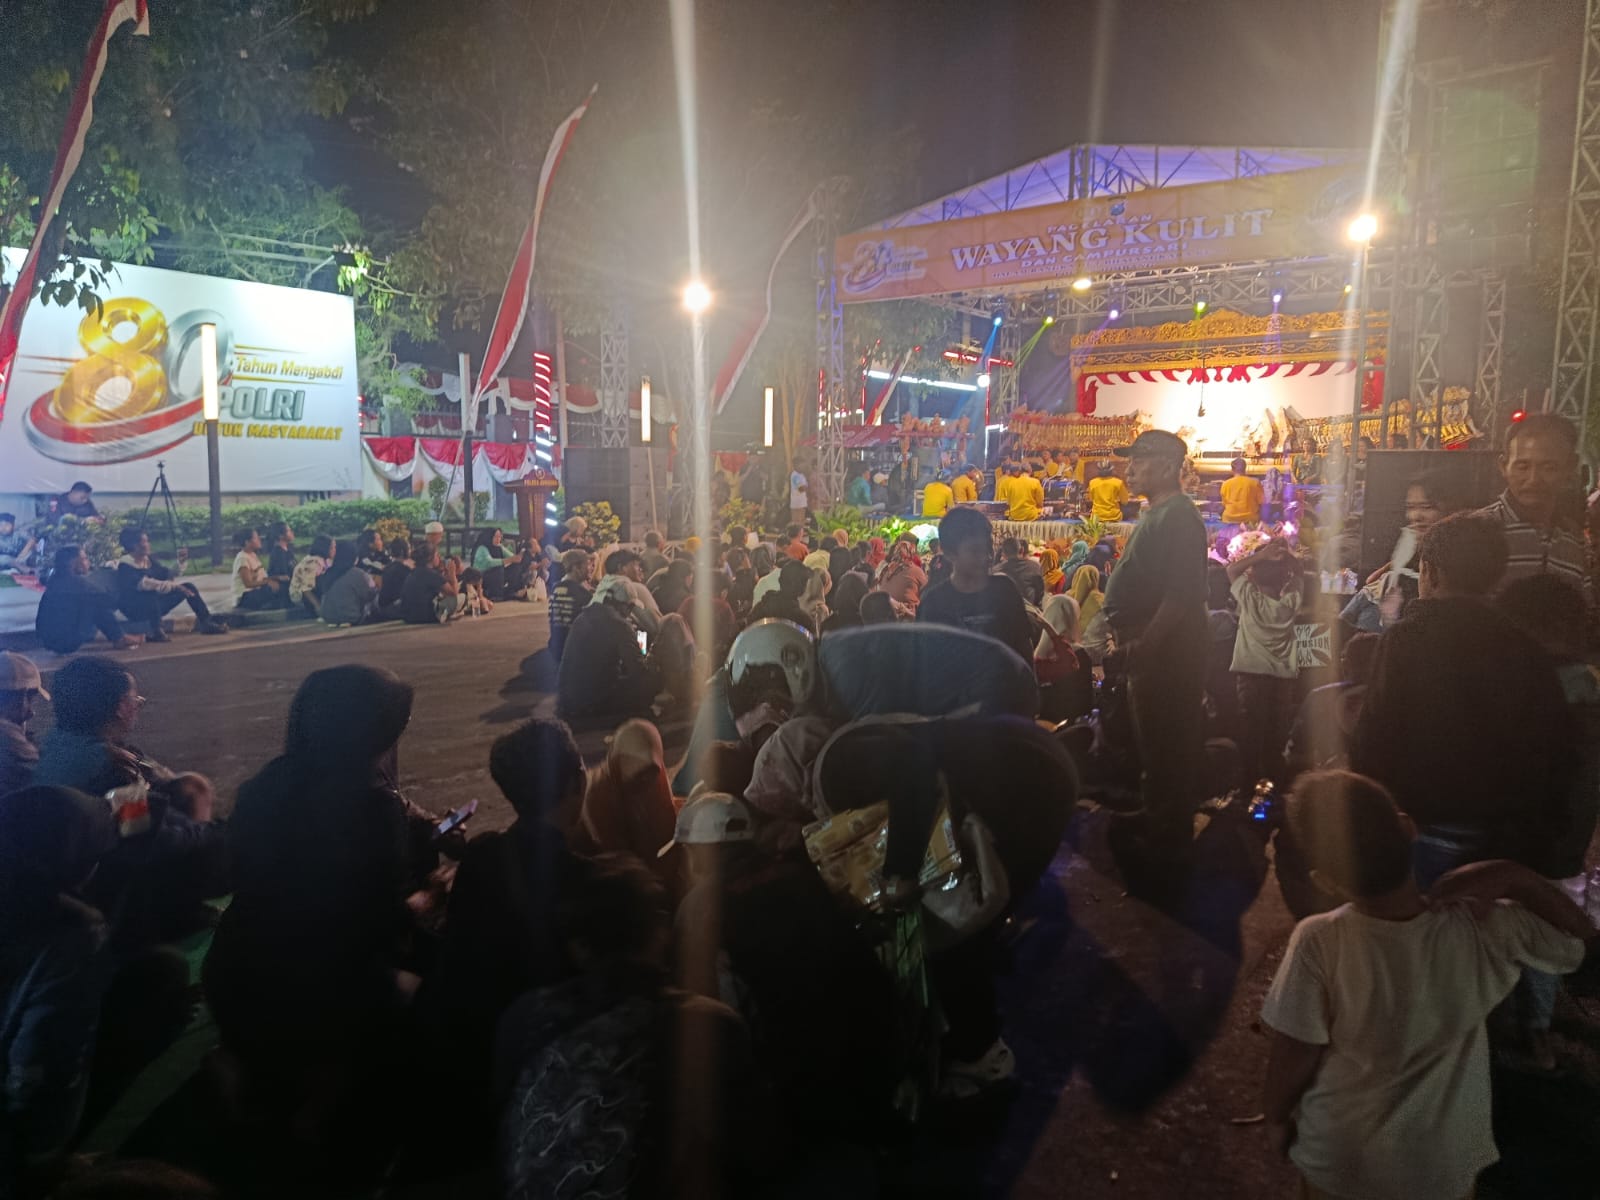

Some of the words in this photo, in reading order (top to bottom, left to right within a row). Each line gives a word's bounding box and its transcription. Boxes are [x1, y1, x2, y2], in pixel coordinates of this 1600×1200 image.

[951, 227, 1108, 271] WAYANG
[1121, 208, 1274, 246] KULIT
[1020, 255, 1056, 269] DAN
[1062, 242, 1189, 263] CAMPURSARI
[236, 356, 278, 374] Tahun
[280, 360, 344, 380] Mengabdi
[217, 386, 306, 421] POLRI
[247, 424, 343, 441] MASYARAKAT
[1296, 636, 1330, 650] FUSION
